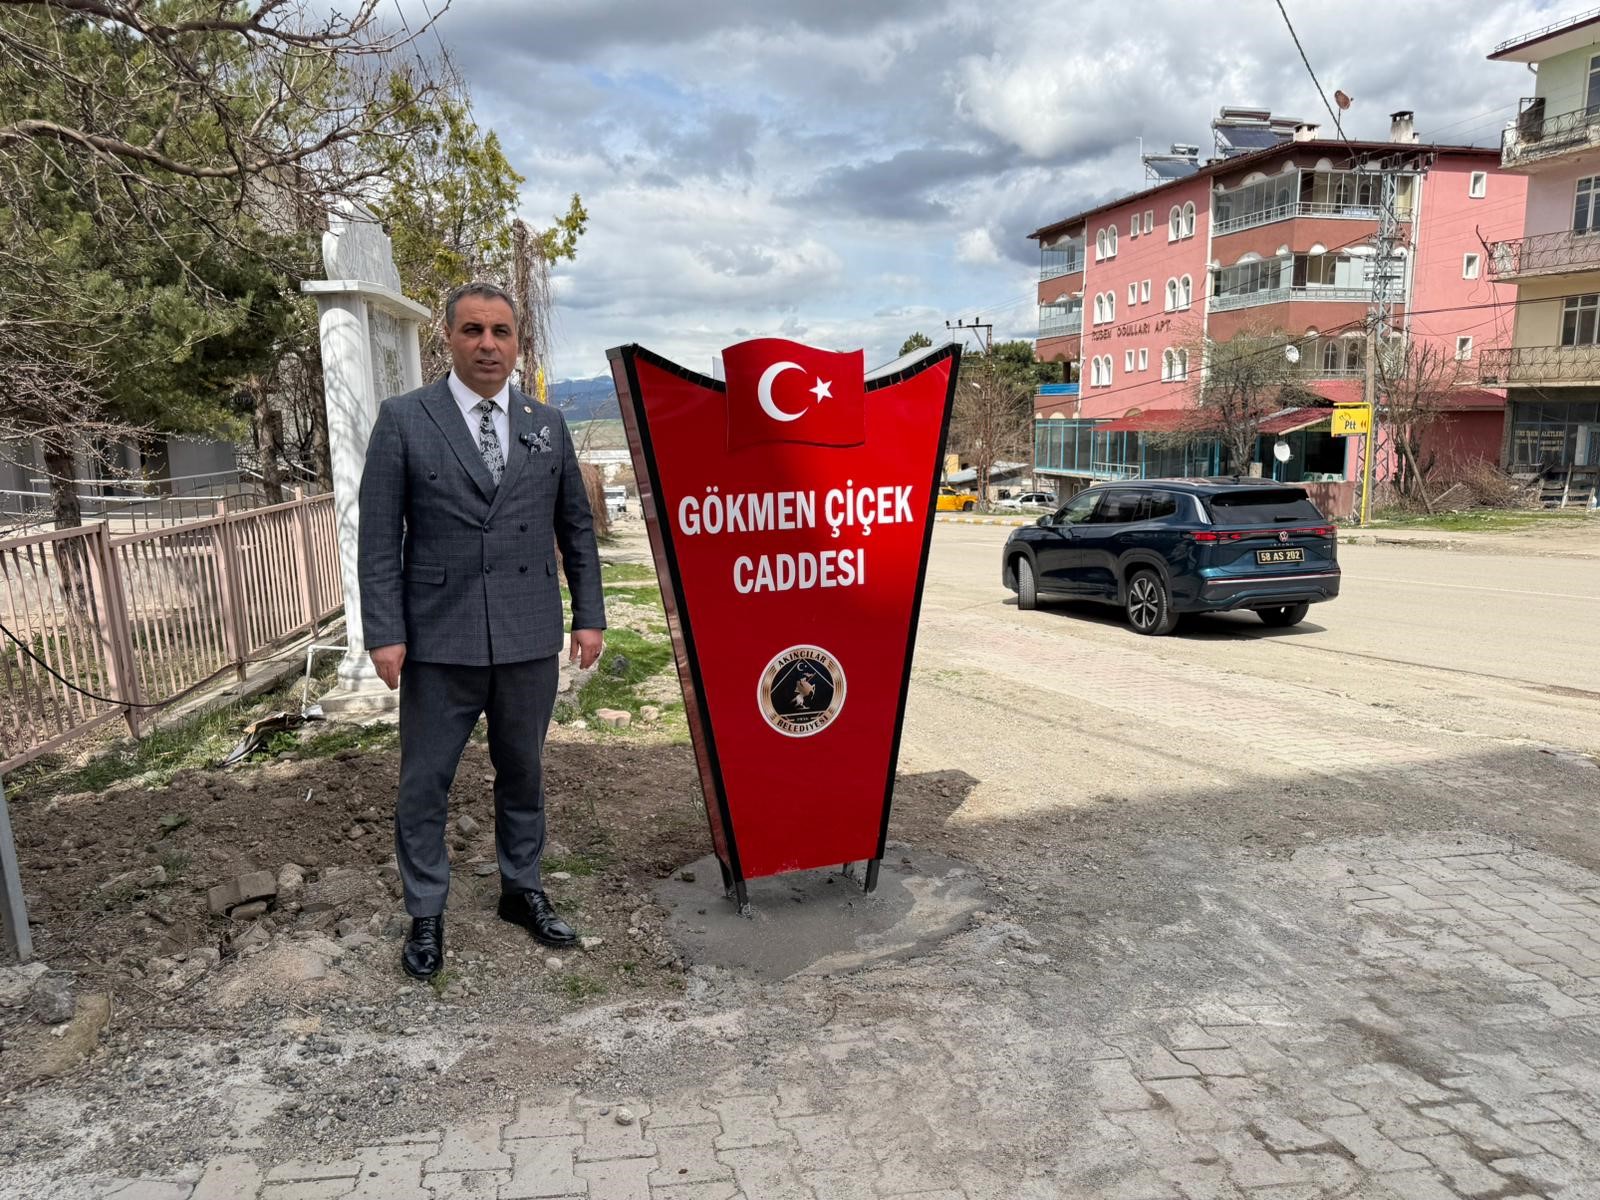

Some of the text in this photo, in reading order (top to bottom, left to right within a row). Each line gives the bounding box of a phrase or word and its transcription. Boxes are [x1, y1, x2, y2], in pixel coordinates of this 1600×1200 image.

[1344, 419, 1357, 430] Ptt
[678, 479, 914, 538] GÖKMEN ÇİÇEK
[1261, 550, 1300, 561] 58 AS 202
[778, 650, 827, 668] AKINCILAR
